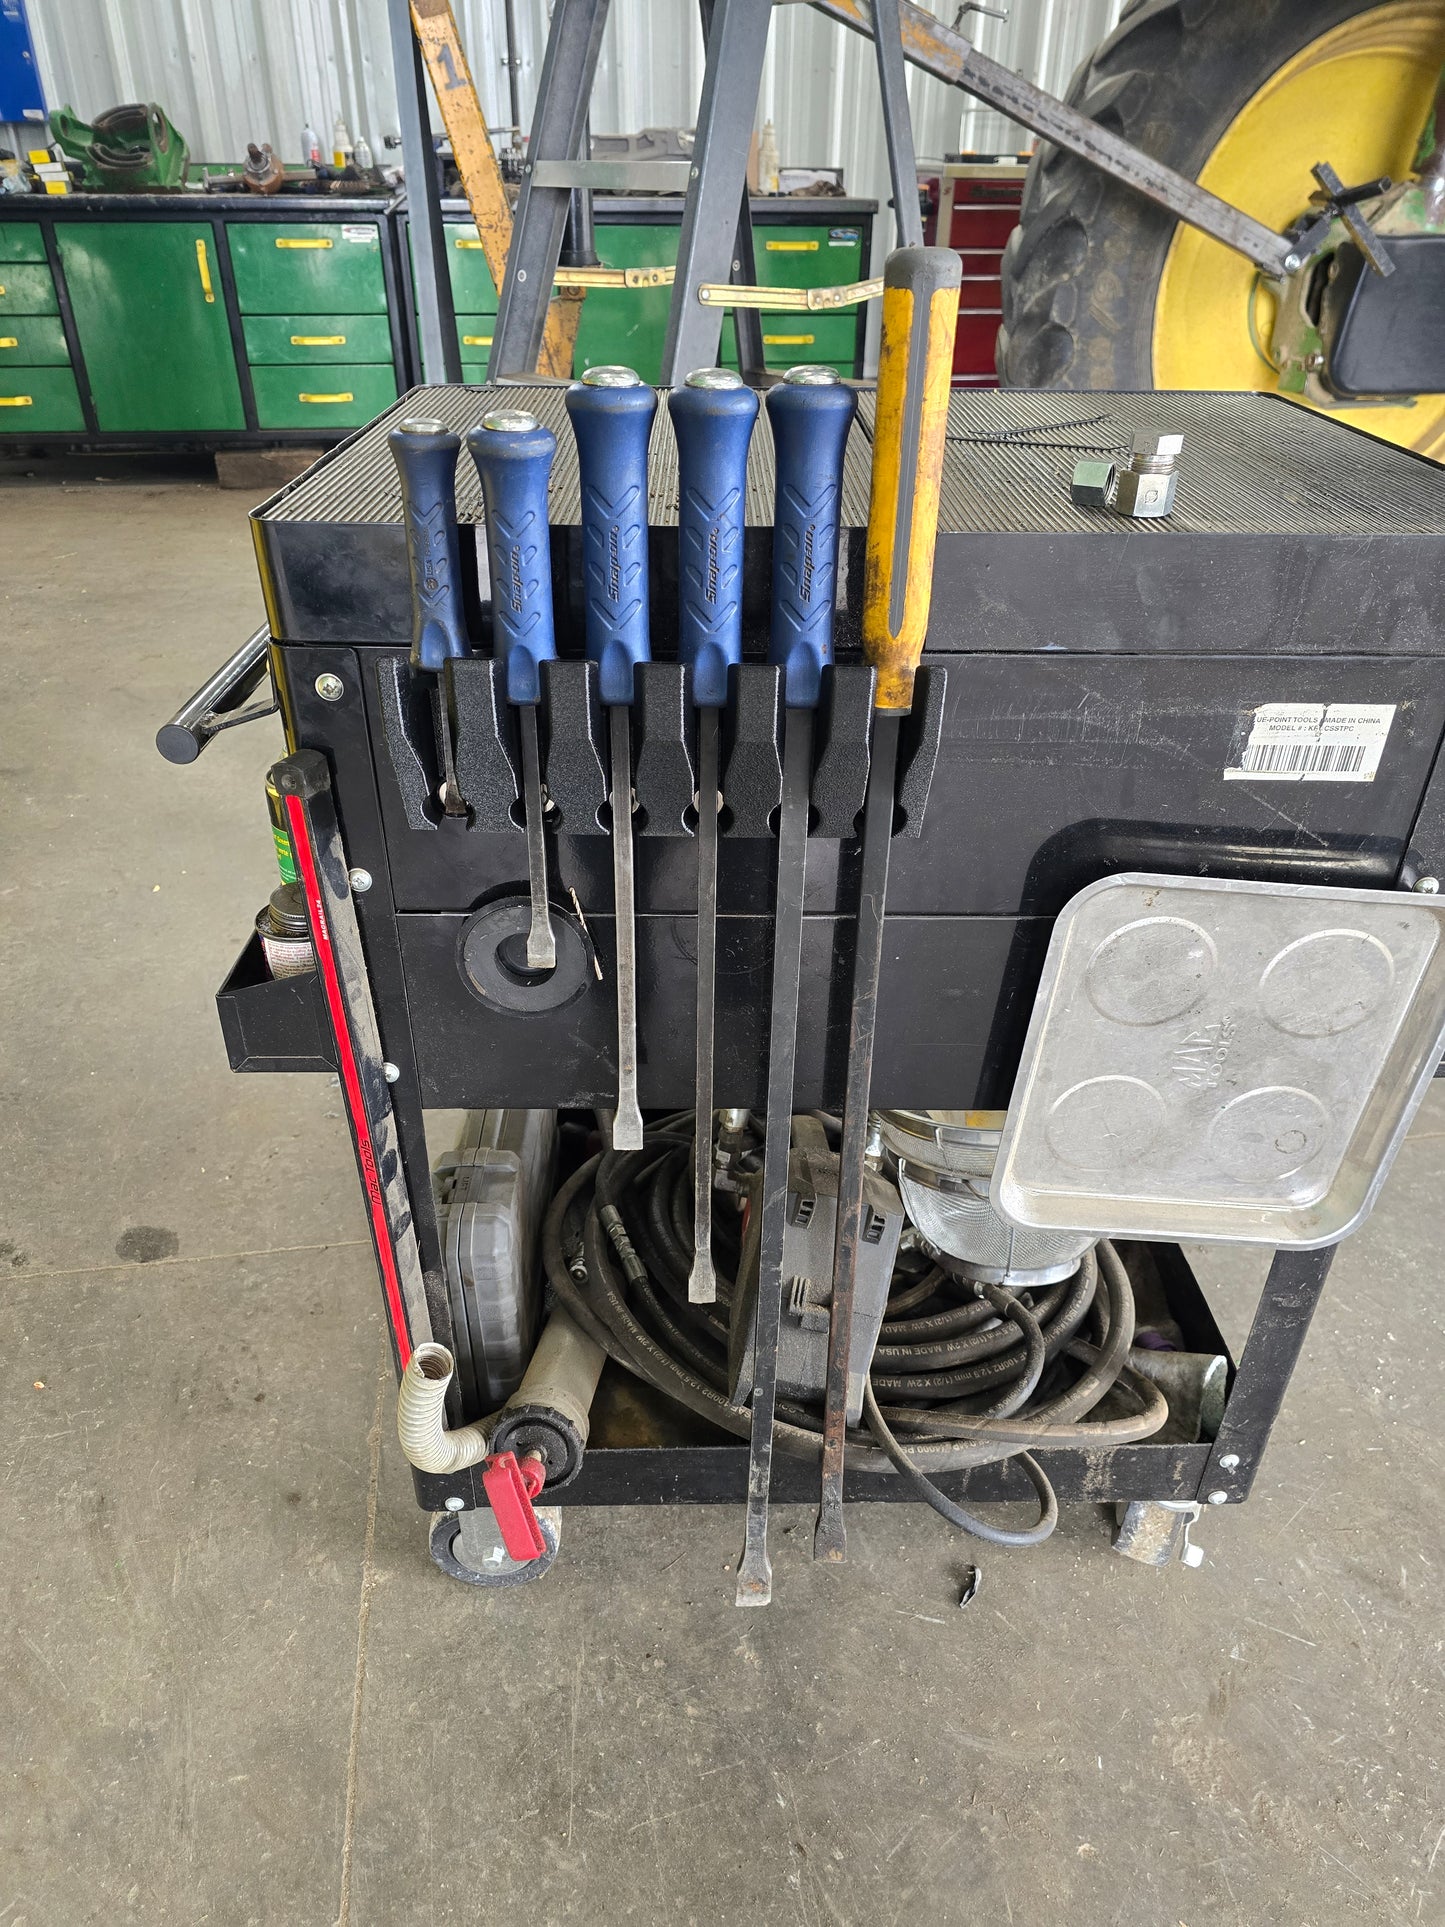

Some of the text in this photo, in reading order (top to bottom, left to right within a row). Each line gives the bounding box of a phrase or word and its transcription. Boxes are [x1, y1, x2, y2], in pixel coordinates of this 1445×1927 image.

[437, 43, 467, 91] 1
[608, 531, 622, 603] Snap-on
[510, 551, 524, 614] Snap-on
[315, 899, 330, 941] MAGRAIL24
[361, 1139, 375, 1173] Tools
[878, 1347, 900, 1357] USA
[901, 1348, 912, 1356] IN
[914, 1345, 942, 1356] MADE
[872, 1379, 902, 1388] MADE
[906, 1379, 923, 1388] 2W
[923, 1378, 932, 1386] X
